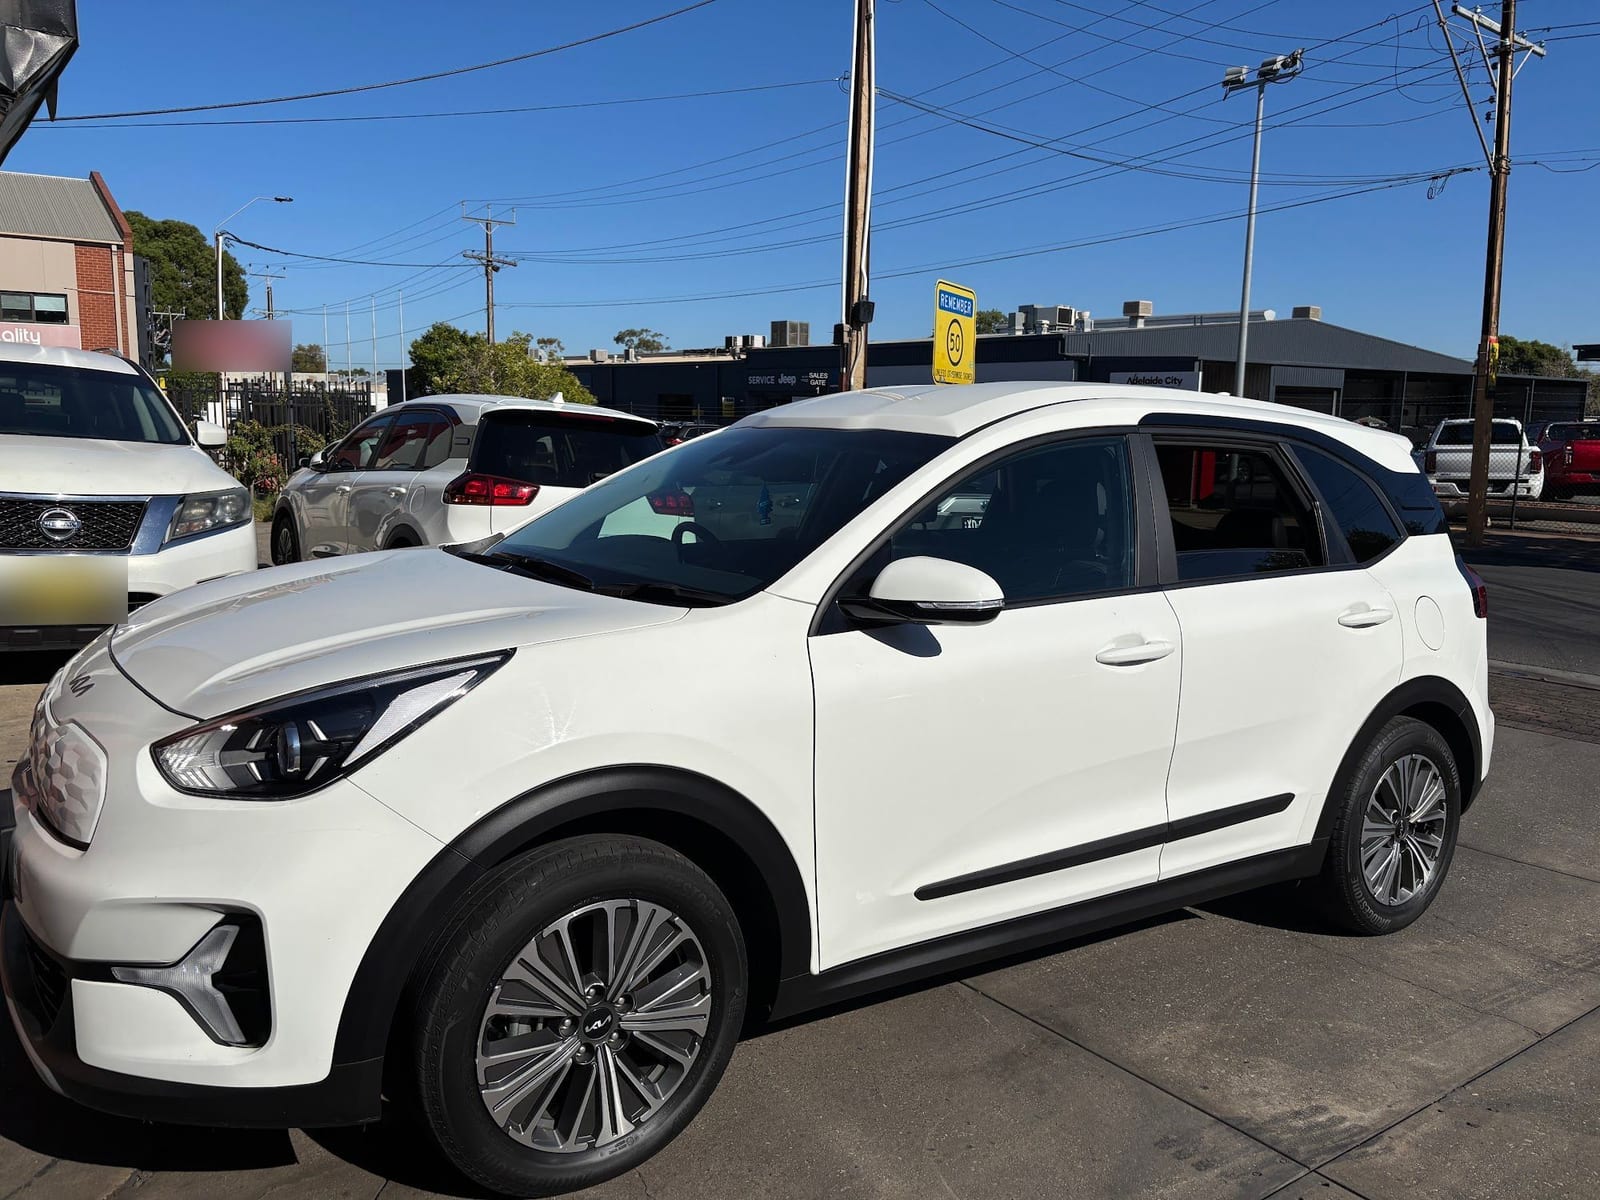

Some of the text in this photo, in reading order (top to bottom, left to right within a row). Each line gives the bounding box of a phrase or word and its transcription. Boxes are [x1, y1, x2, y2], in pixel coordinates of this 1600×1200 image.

[940, 293, 972, 315] REMEMBER
[950, 333, 960, 352] 50
[748, 375, 775, 385] SERVICE
[777, 373, 797, 386] Jeep
[1126, 374, 1183, 386] Adelaide City
[815, 386, 820, 394] 1
[41, 519, 78, 529] NIAN
